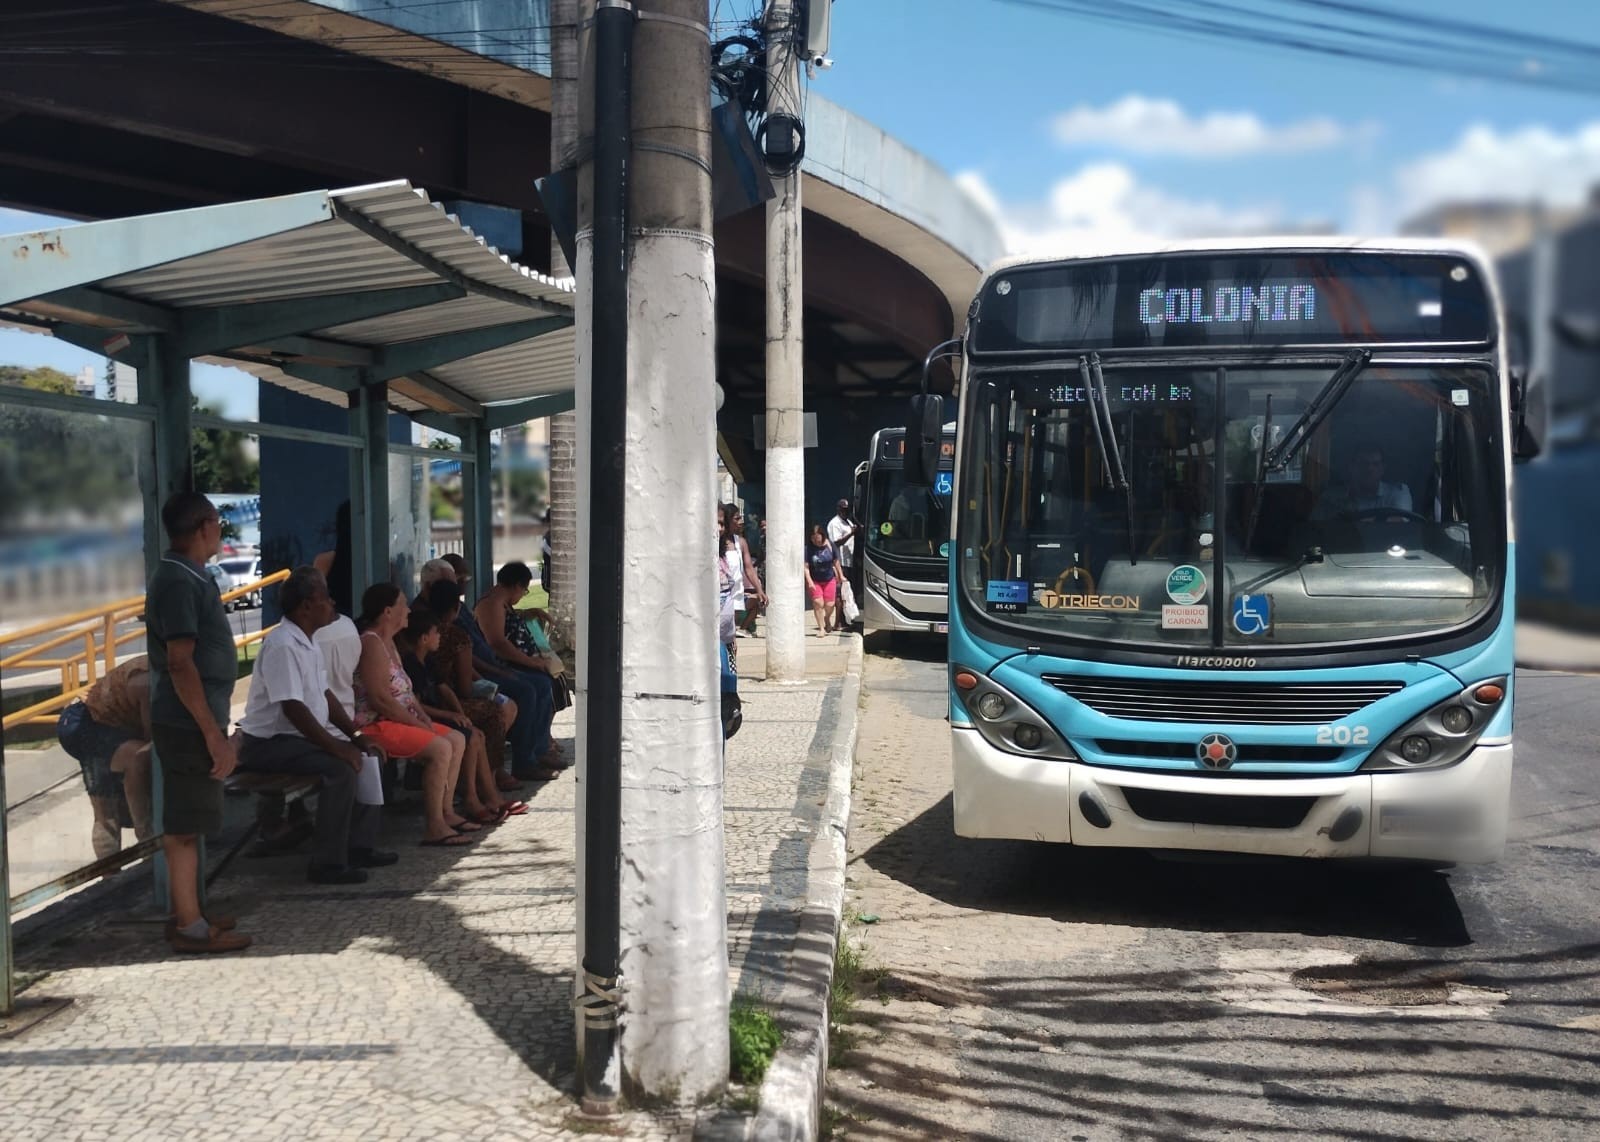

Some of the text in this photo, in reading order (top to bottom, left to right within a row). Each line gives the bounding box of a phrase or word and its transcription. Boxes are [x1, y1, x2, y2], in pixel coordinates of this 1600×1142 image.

[1139, 285, 1315, 324] COLONIA
[1059, 594, 1139, 609] TRIECON
[1165, 608, 1205, 616] PROIBIDO
[1168, 617, 1203, 625] CARONA
[1177, 656, 1257, 669] Marcopolo
[1316, 725, 1369, 745] 202
